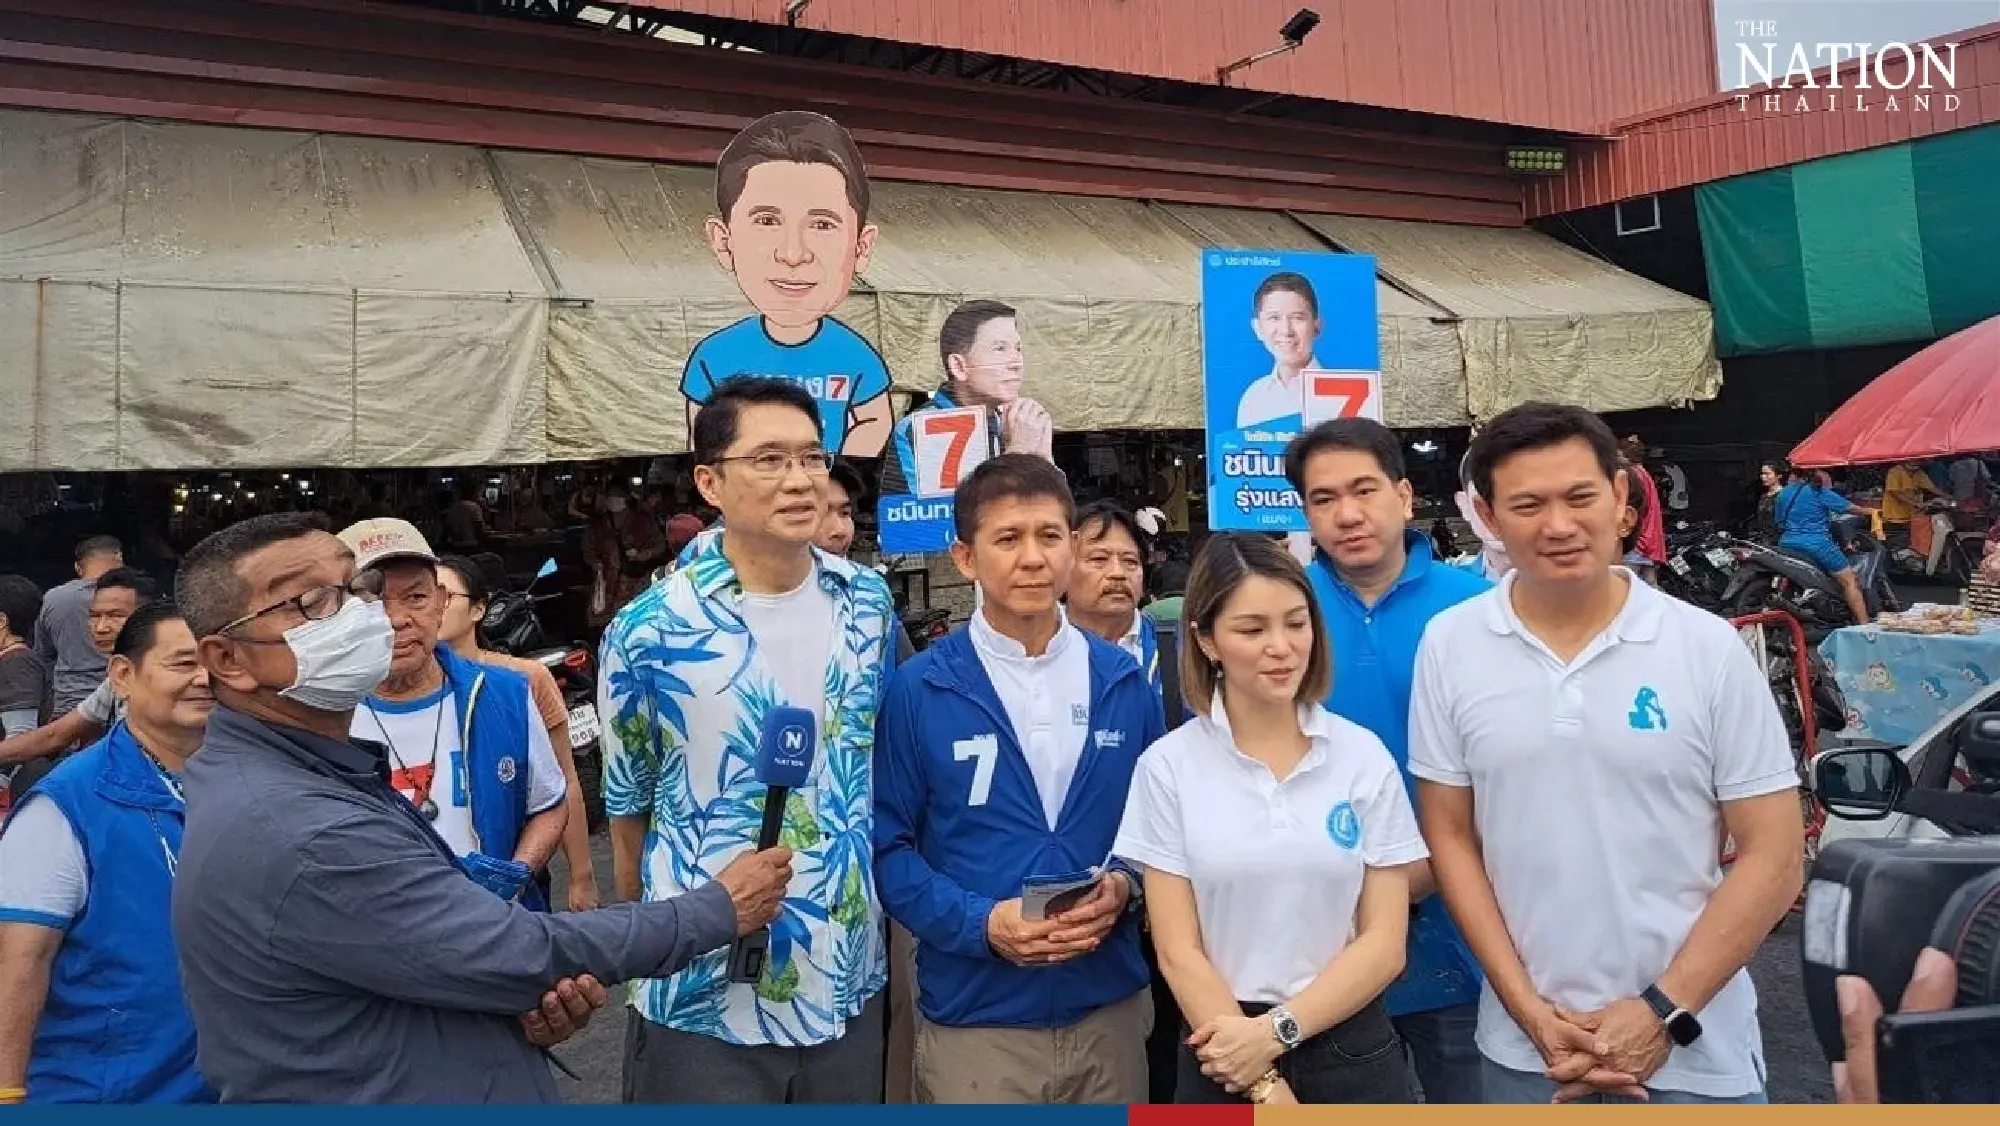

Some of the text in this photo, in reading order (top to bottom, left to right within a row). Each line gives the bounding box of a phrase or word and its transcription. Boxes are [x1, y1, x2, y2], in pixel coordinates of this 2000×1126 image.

[831, 377, 847, 399] 7
[1314, 378, 1371, 419] 7
[925, 413, 977, 489] 7
[1223, 450, 1287, 477] ชนิน
[887, 501, 955, 522] ชนินท
[785, 731, 802, 749] N
[953, 739, 998, 806] 7
